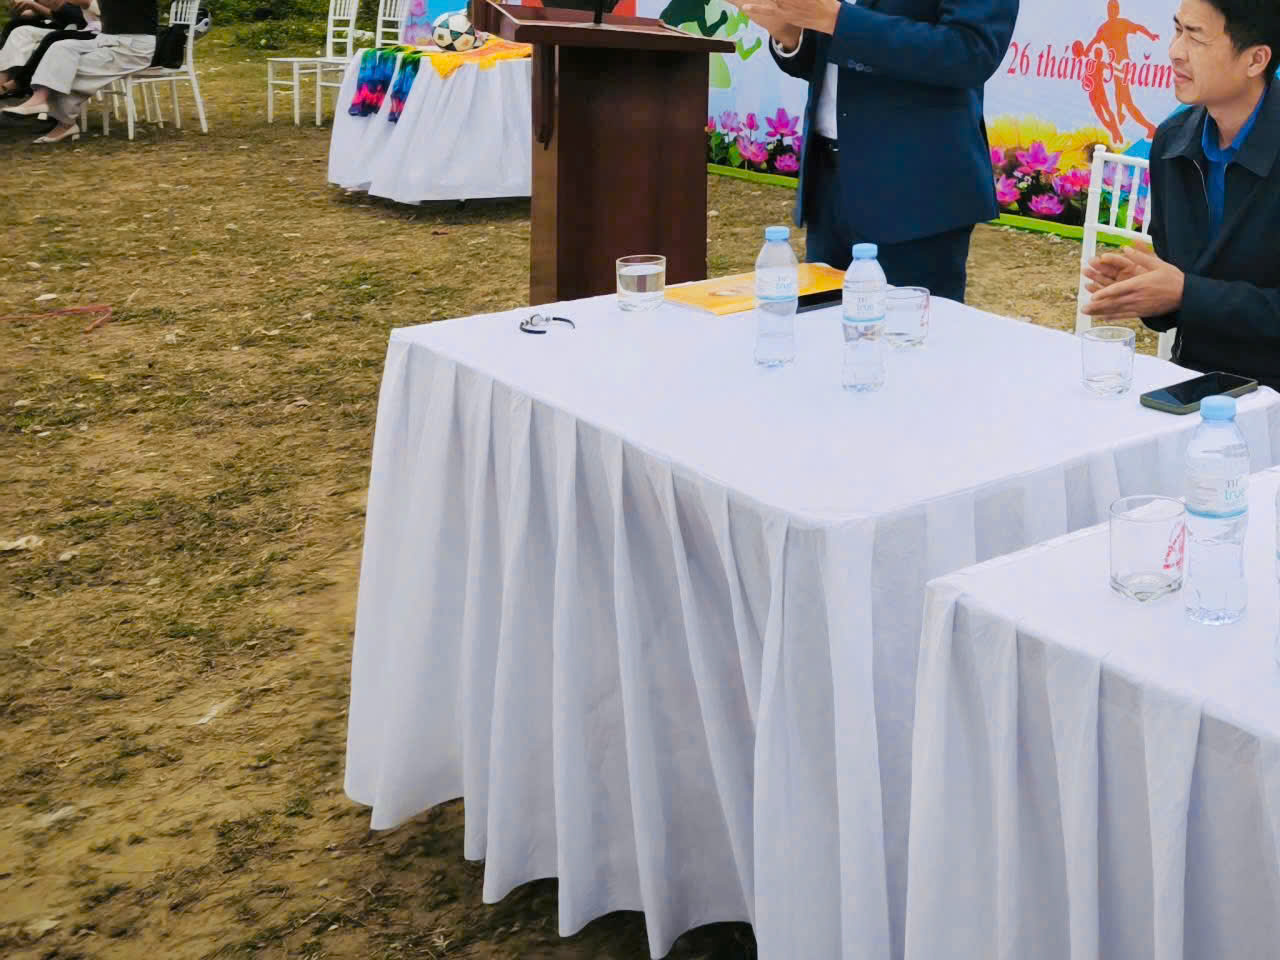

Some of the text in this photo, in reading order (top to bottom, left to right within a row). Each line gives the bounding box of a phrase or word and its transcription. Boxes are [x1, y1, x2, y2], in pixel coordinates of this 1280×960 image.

[1007, 41, 1173, 91] 26 tháng 3 năm
